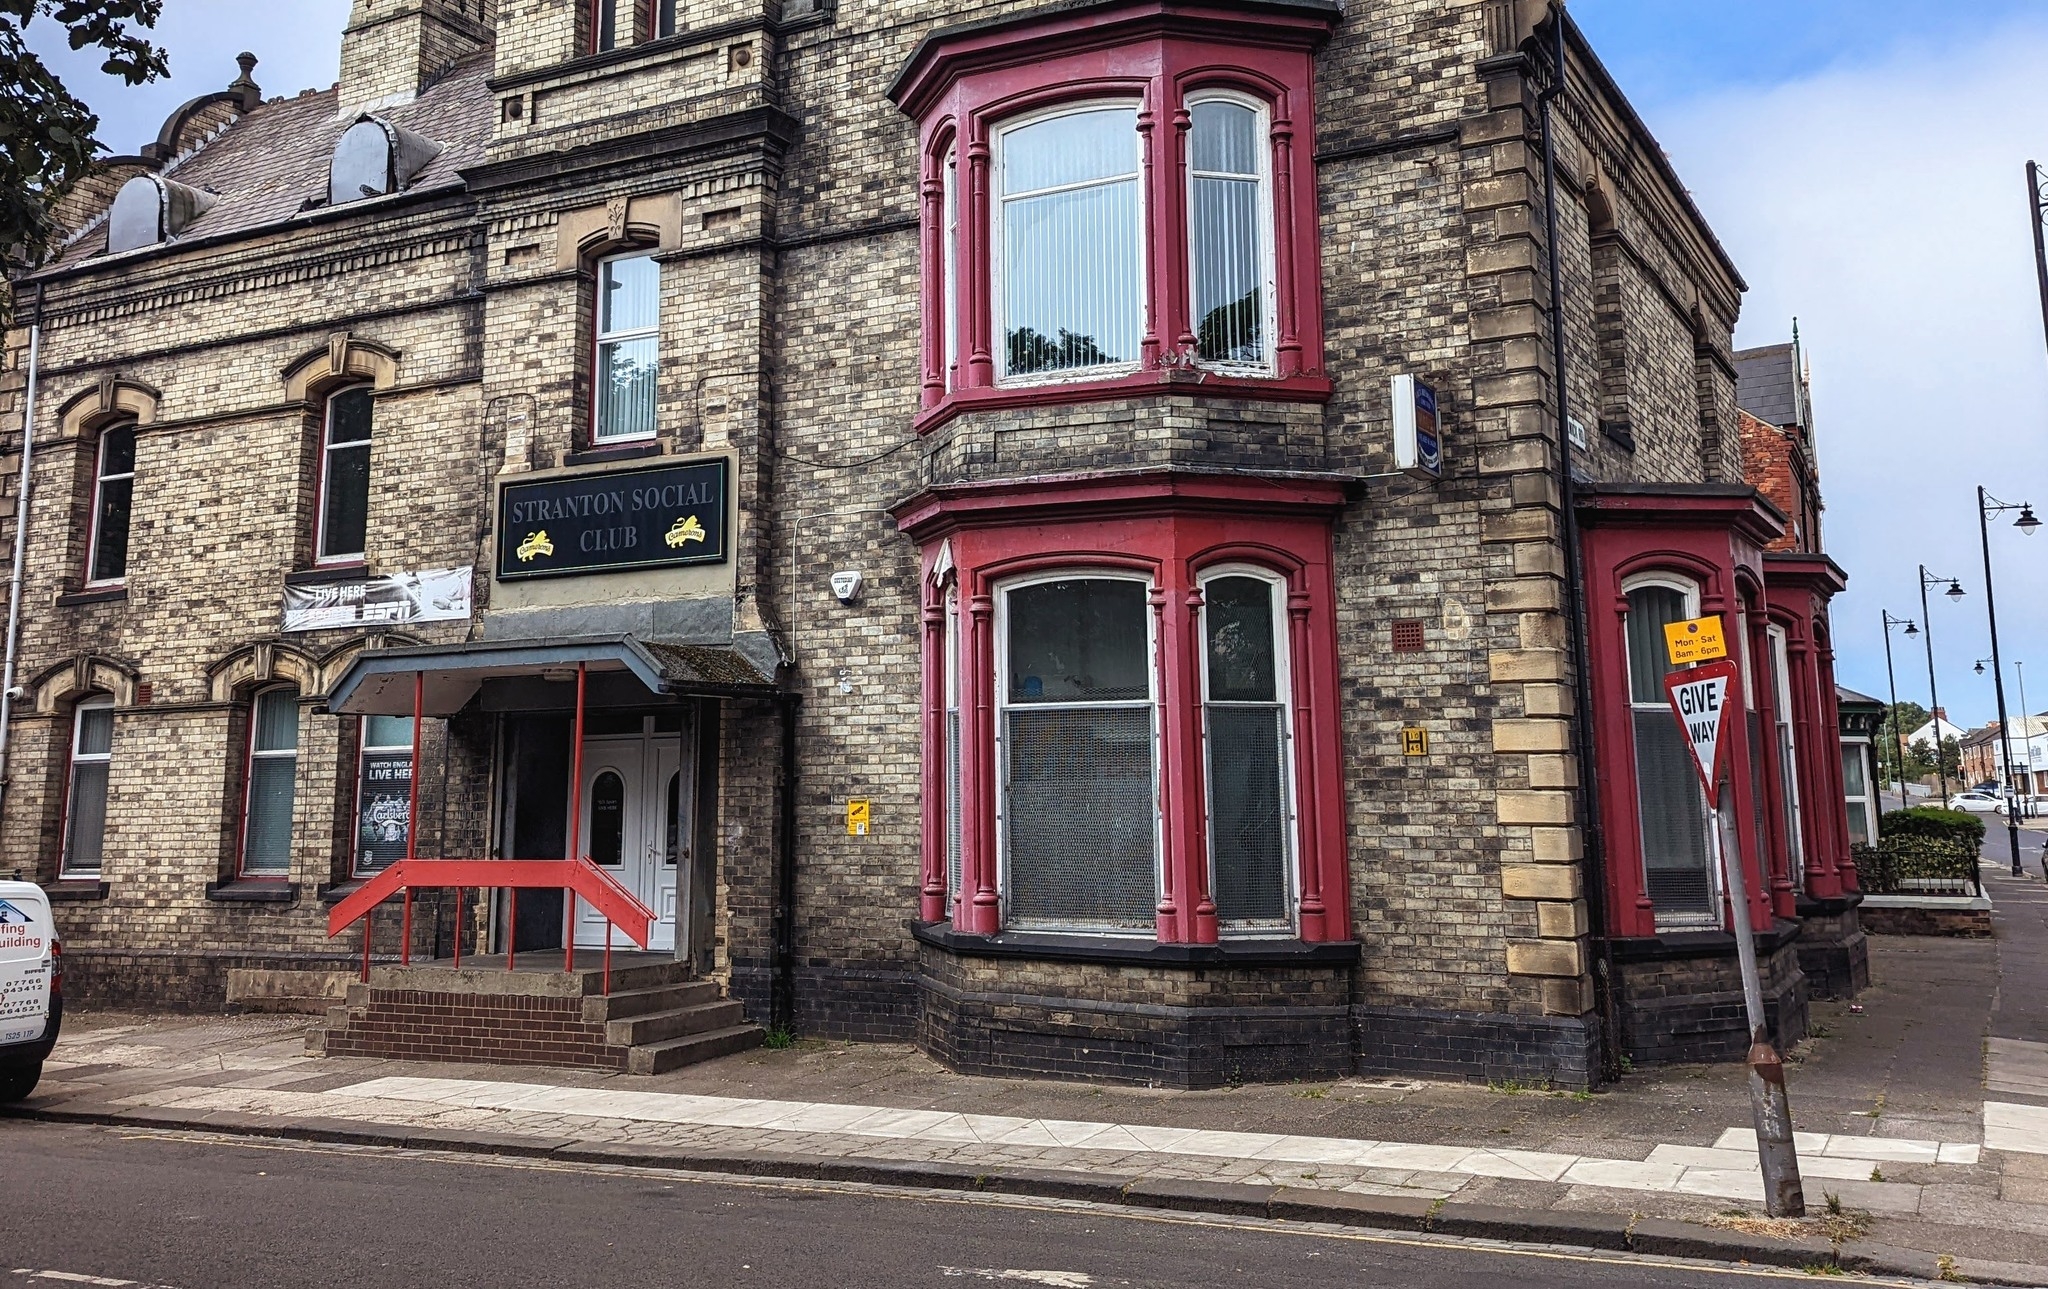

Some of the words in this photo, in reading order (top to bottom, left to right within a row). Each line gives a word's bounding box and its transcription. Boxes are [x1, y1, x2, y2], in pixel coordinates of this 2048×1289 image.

[512, 490, 625, 524] STRANTON
[631, 481, 714, 511] SOCIAL
[579, 525, 638, 552] CLUB
[315, 588, 338, 600] LIVE
[339, 584, 367, 599] HERE
[362, 600, 411, 620] ESPN
[1675, 639, 1694, 647] Mon
[1700, 634, 1716, 643] Sat
[1675, 650, 1694, 658] 8am
[1700, 646, 1720, 655] 6pm
[1680, 682, 1718, 716] GIVE
[1689, 720, 1715, 744] WAY
[370, 761, 392, 769] WATCH
[392, 761, 413, 769] ENGLA
[369, 769, 392, 780] LIVE
[3, 985, 43, 993] 943412
[6, 978, 41, 987] 07766
[3, 999, 39, 1008] 07768
